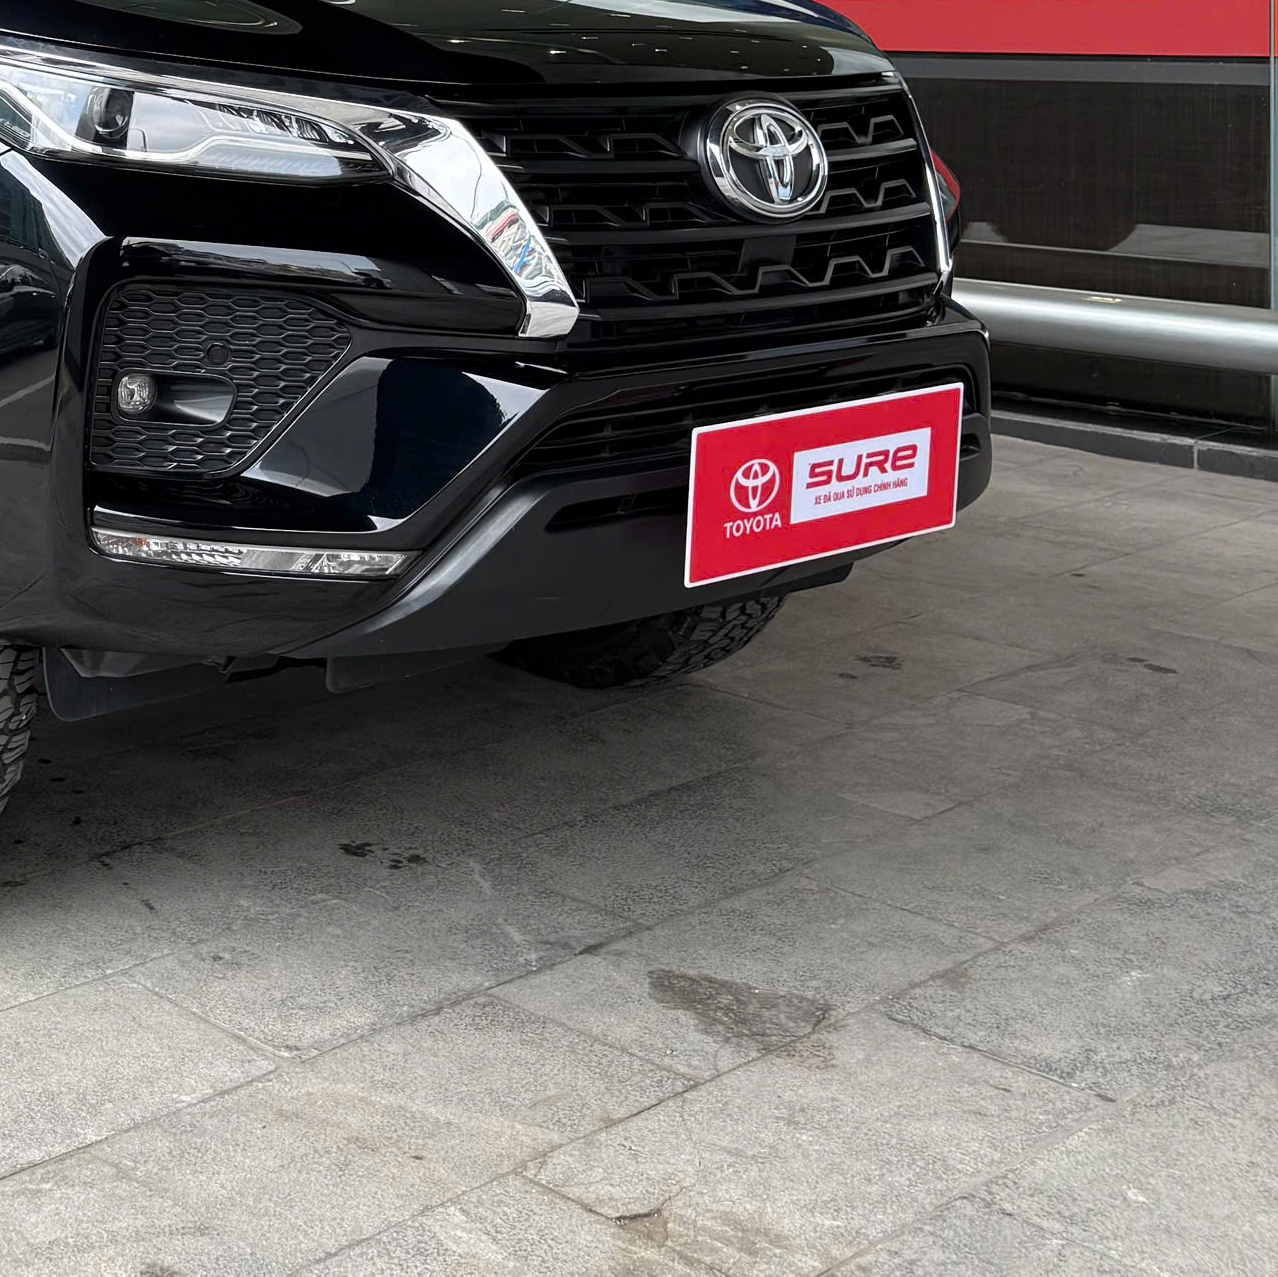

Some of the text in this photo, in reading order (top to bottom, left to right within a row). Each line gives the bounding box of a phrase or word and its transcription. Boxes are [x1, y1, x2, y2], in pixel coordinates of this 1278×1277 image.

[814, 495, 822, 506] XE
[833, 490, 845, 502] QUA
[724, 512, 781, 539] TOYOTA
